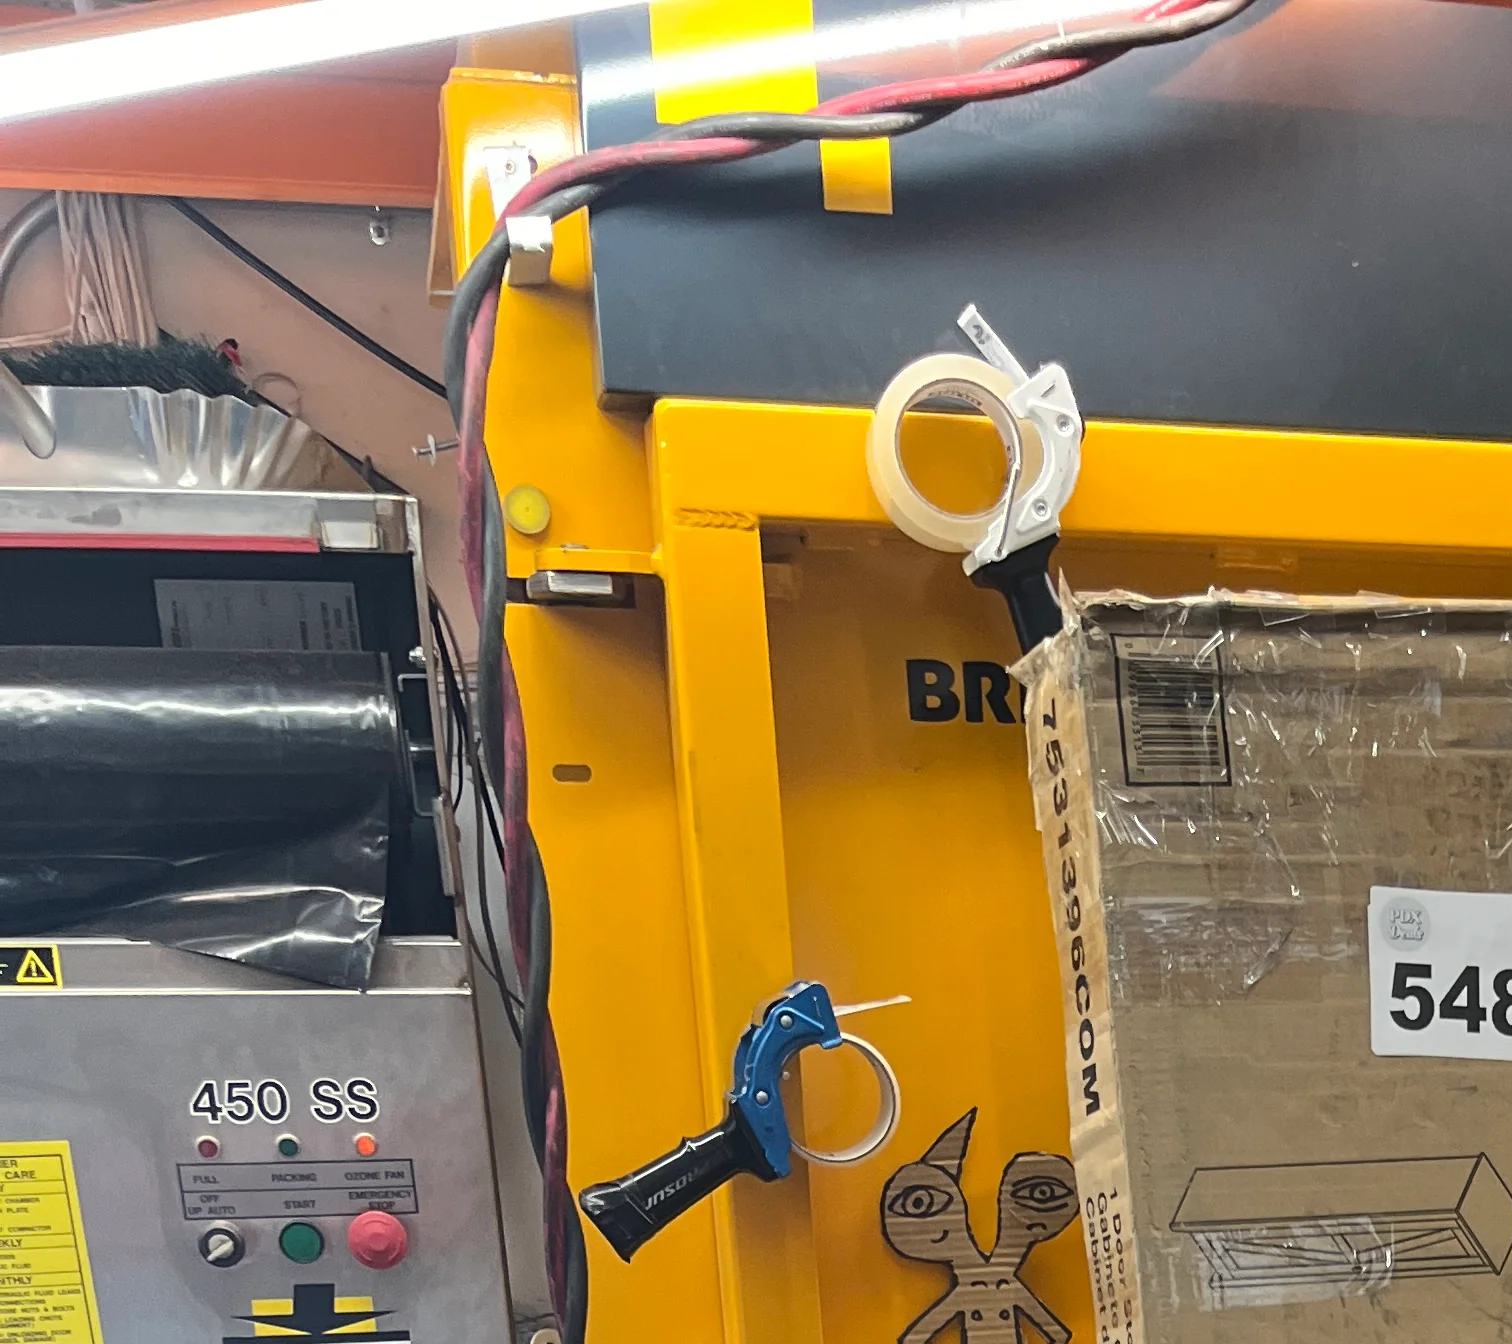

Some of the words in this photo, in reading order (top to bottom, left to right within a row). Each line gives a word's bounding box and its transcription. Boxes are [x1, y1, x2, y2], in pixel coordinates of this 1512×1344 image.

[906, 659, 1027, 725] BR
[1042, 698, 1101, 1117] 7531396COM
[1389, 909, 1423, 924] PDX
[190, 1079, 290, 1125] 450
[310, 1078, 379, 1123] SS
[4, 1170, 36, 1179] CARE
[193, 1175, 219, 1184] FULL
[272, 1172, 317, 1183] PACKING
[345, 1171, 380, 1181] OZONE
[384, 1170, 404, 1180] FAN
[200, 1195, 220, 1204] OFF
[349, 1190, 412, 1200] EMERGENCY
[188, 1206, 203, 1216] UP
[208, 1205, 236, 1215] AUTO
[284, 1200, 316, 1210] START
[368, 1201, 396, 1210] STOP
[1086, 1196, 1107, 1316] Cabinet
[1112, 1213, 1128, 1290] Door
[1098, 1192, 1119, 1329] Gabinete
